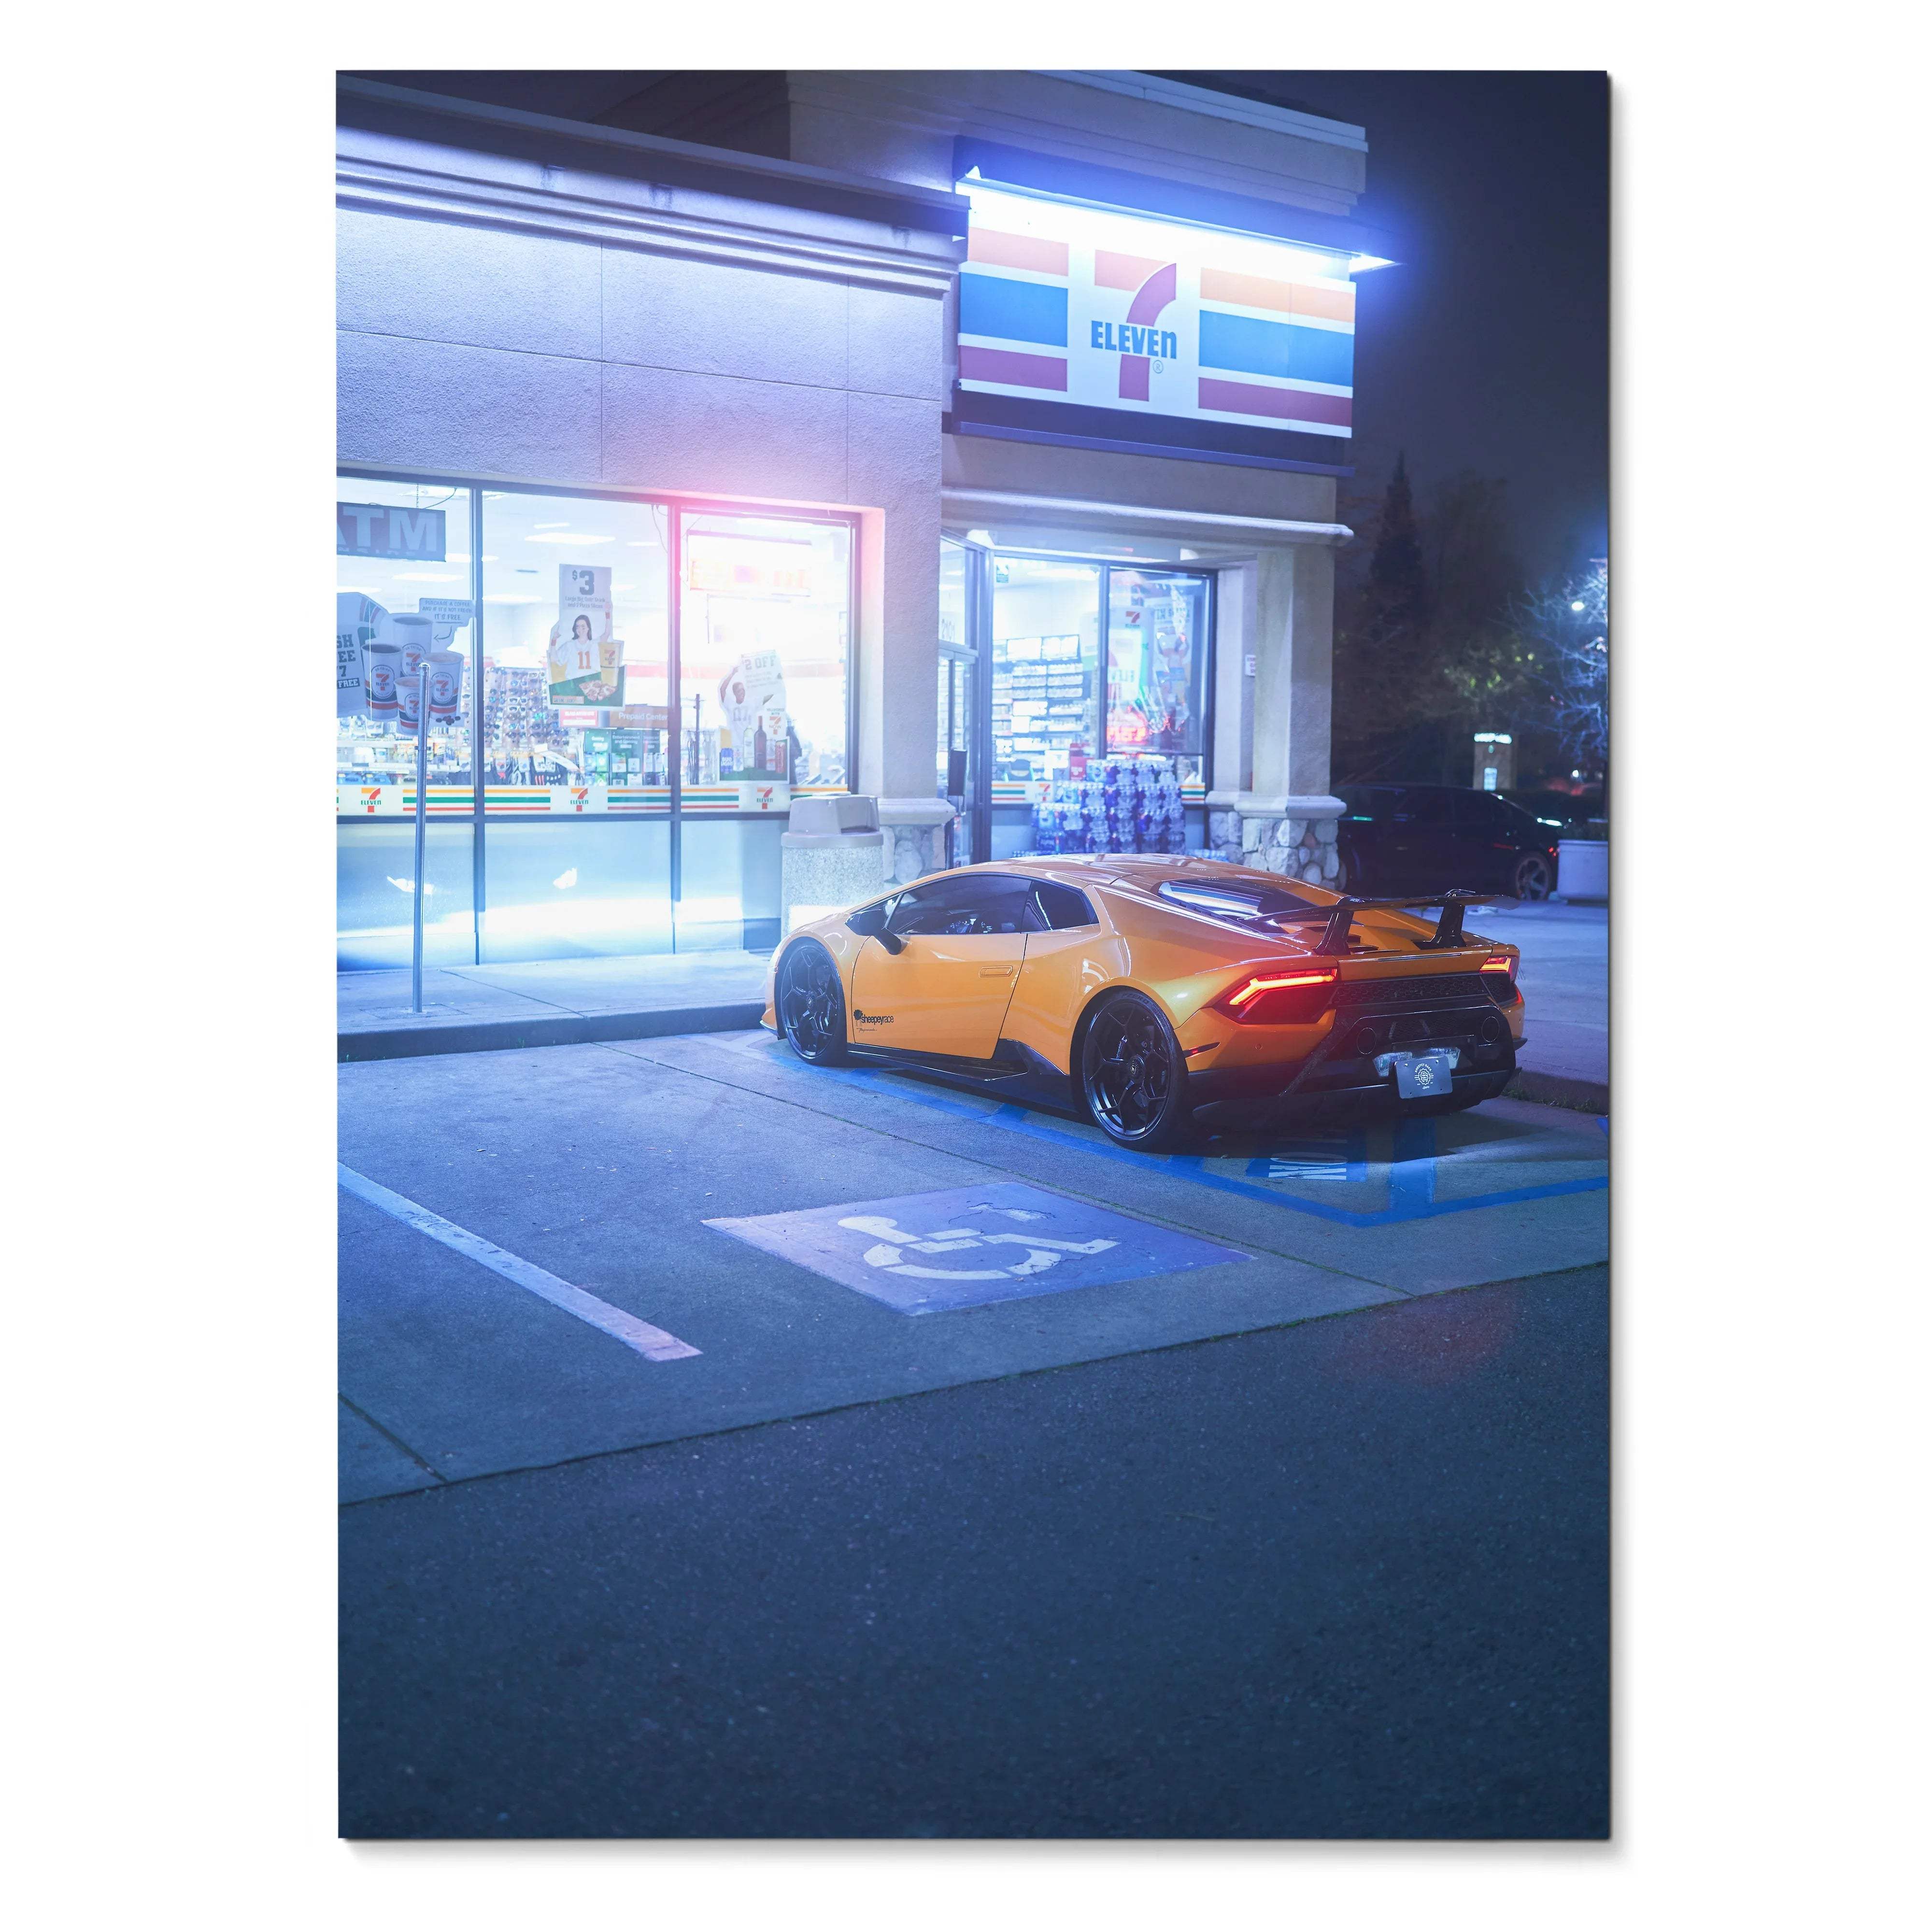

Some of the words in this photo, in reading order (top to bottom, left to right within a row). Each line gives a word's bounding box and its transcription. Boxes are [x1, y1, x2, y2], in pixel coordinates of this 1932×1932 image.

[1094, 249, 1177, 402] 7
[578, 651, 591, 669] 11
[338, 679, 358, 688] FREE
[618, 712, 645, 721] Prepaid
[361, 787, 381, 812] 7
[571, 788, 588, 812] 7
[757, 787, 773, 810] 7
[861, 1014, 894, 1025] sheepeyrace
